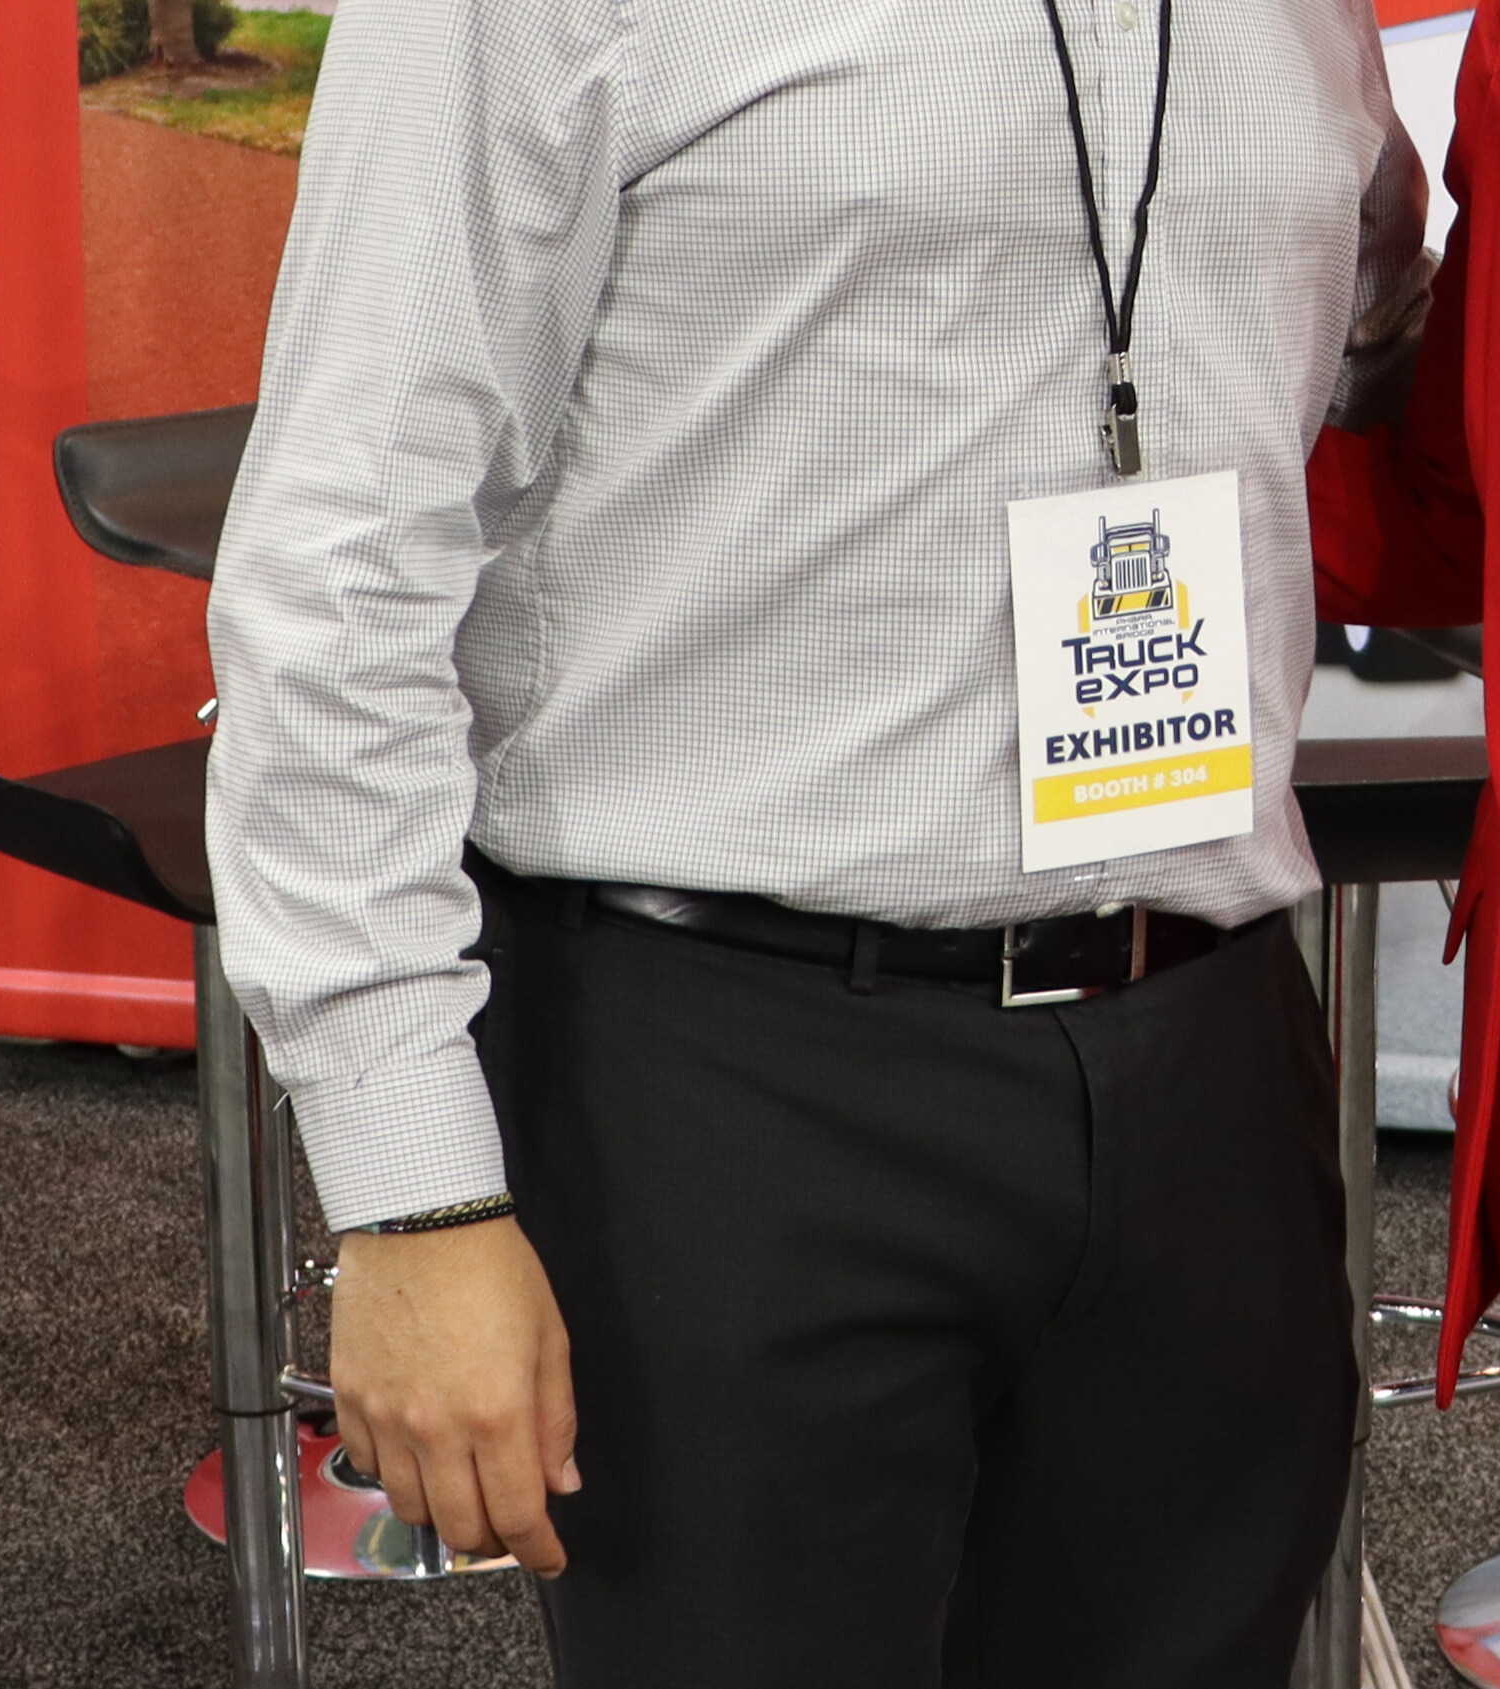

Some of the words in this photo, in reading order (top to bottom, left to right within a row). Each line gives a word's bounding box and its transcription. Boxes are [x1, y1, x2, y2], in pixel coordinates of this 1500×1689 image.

[1061, 617, 1208, 676] TRUCK
[1046, 708, 1237, 765] EXHIBITOR
[1073, 776, 1149, 804] BOOTH
[1170, 765, 1208, 787] 304
